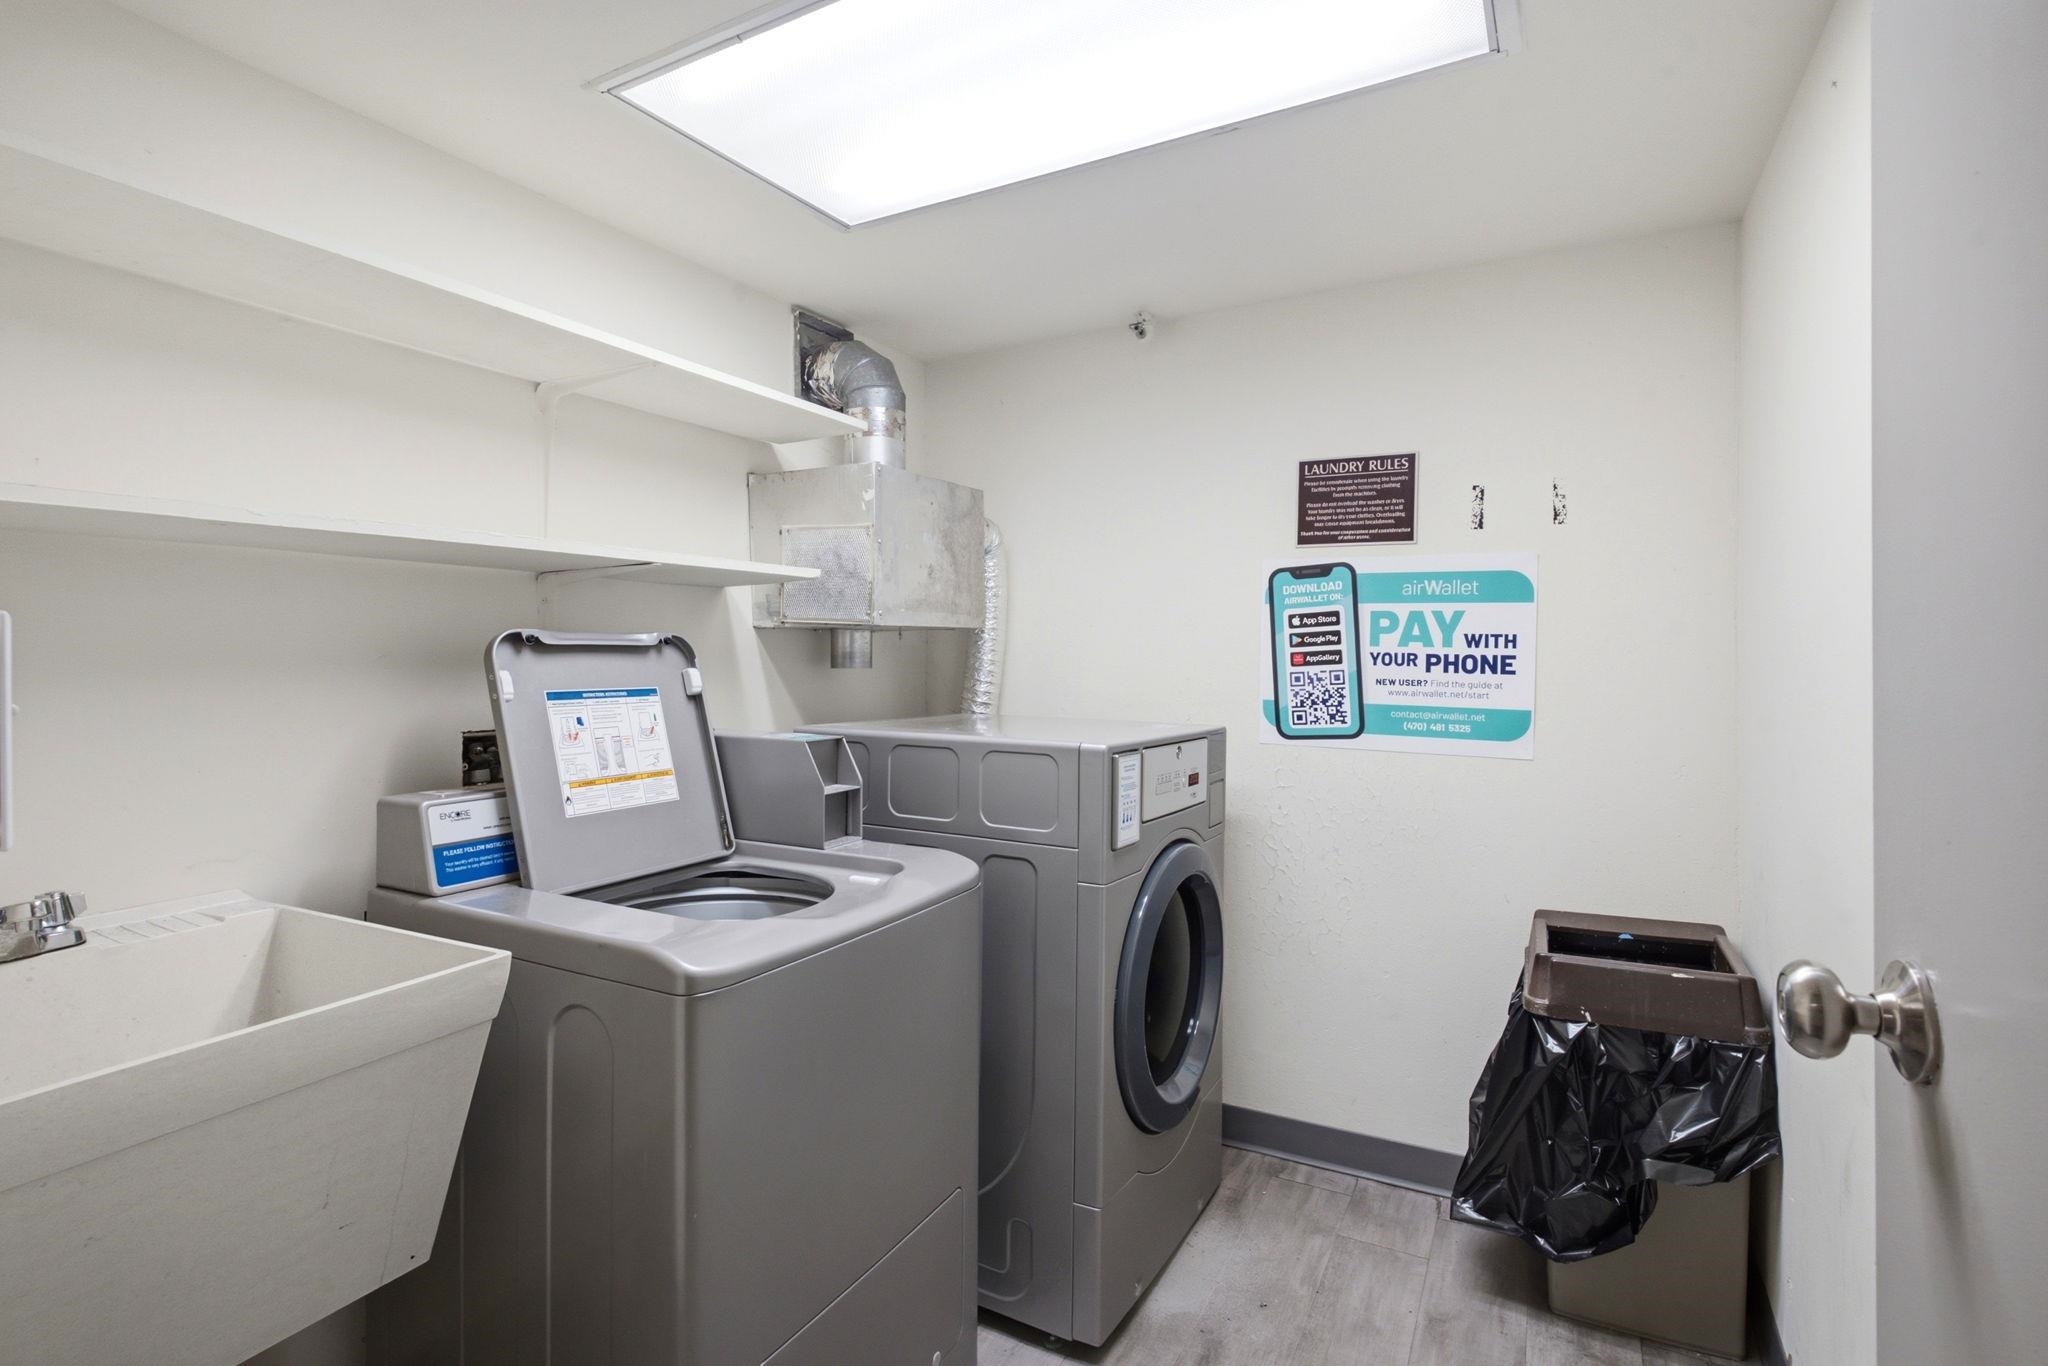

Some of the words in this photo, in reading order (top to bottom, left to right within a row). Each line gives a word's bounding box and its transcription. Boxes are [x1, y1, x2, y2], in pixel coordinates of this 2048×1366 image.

[1304, 461, 1365, 475] LAUNDRY
[1369, 457, 1409, 471] RULES
[1283, 581, 1343, 595] DOWNLOAD
[1402, 580, 1479, 596] airWallet
[1284, 594, 1329, 605] AIRWALLET
[1329, 592, 1344, 601] ON:
[1302, 617, 1317, 625] App
[1317, 615, 1337, 624] Store
[1369, 610, 1466, 648] PAY
[1464, 633, 1518, 649] WITH
[1304, 634, 1326, 644] Google
[1325, 633, 1340, 643] Play
[1305, 653, 1341, 663] AppGallery
[1370, 652, 1418, 667] YOUR
[1425, 653, 1517, 675] PHONE
[1375, 678, 1397, 687] NEW
[1398, 678, 1429, 688] USER?
[1430, 680, 1450, 689] Find
[1451, 680, 1466, 689] the
[1467, 681, 1493, 691] guide
[1494, 682, 1504, 690] at
[1387, 688, 1490, 700] www.airwallet.net/start
[1390, 710, 1486, 722] contact@airwallet.net
[1403, 721, 1427, 732] (470)
[1430, 722, 1446, 732] 481
[443, 847, 464, 857] PLEASE
[464, 844, 485, 854] FOLLOW
